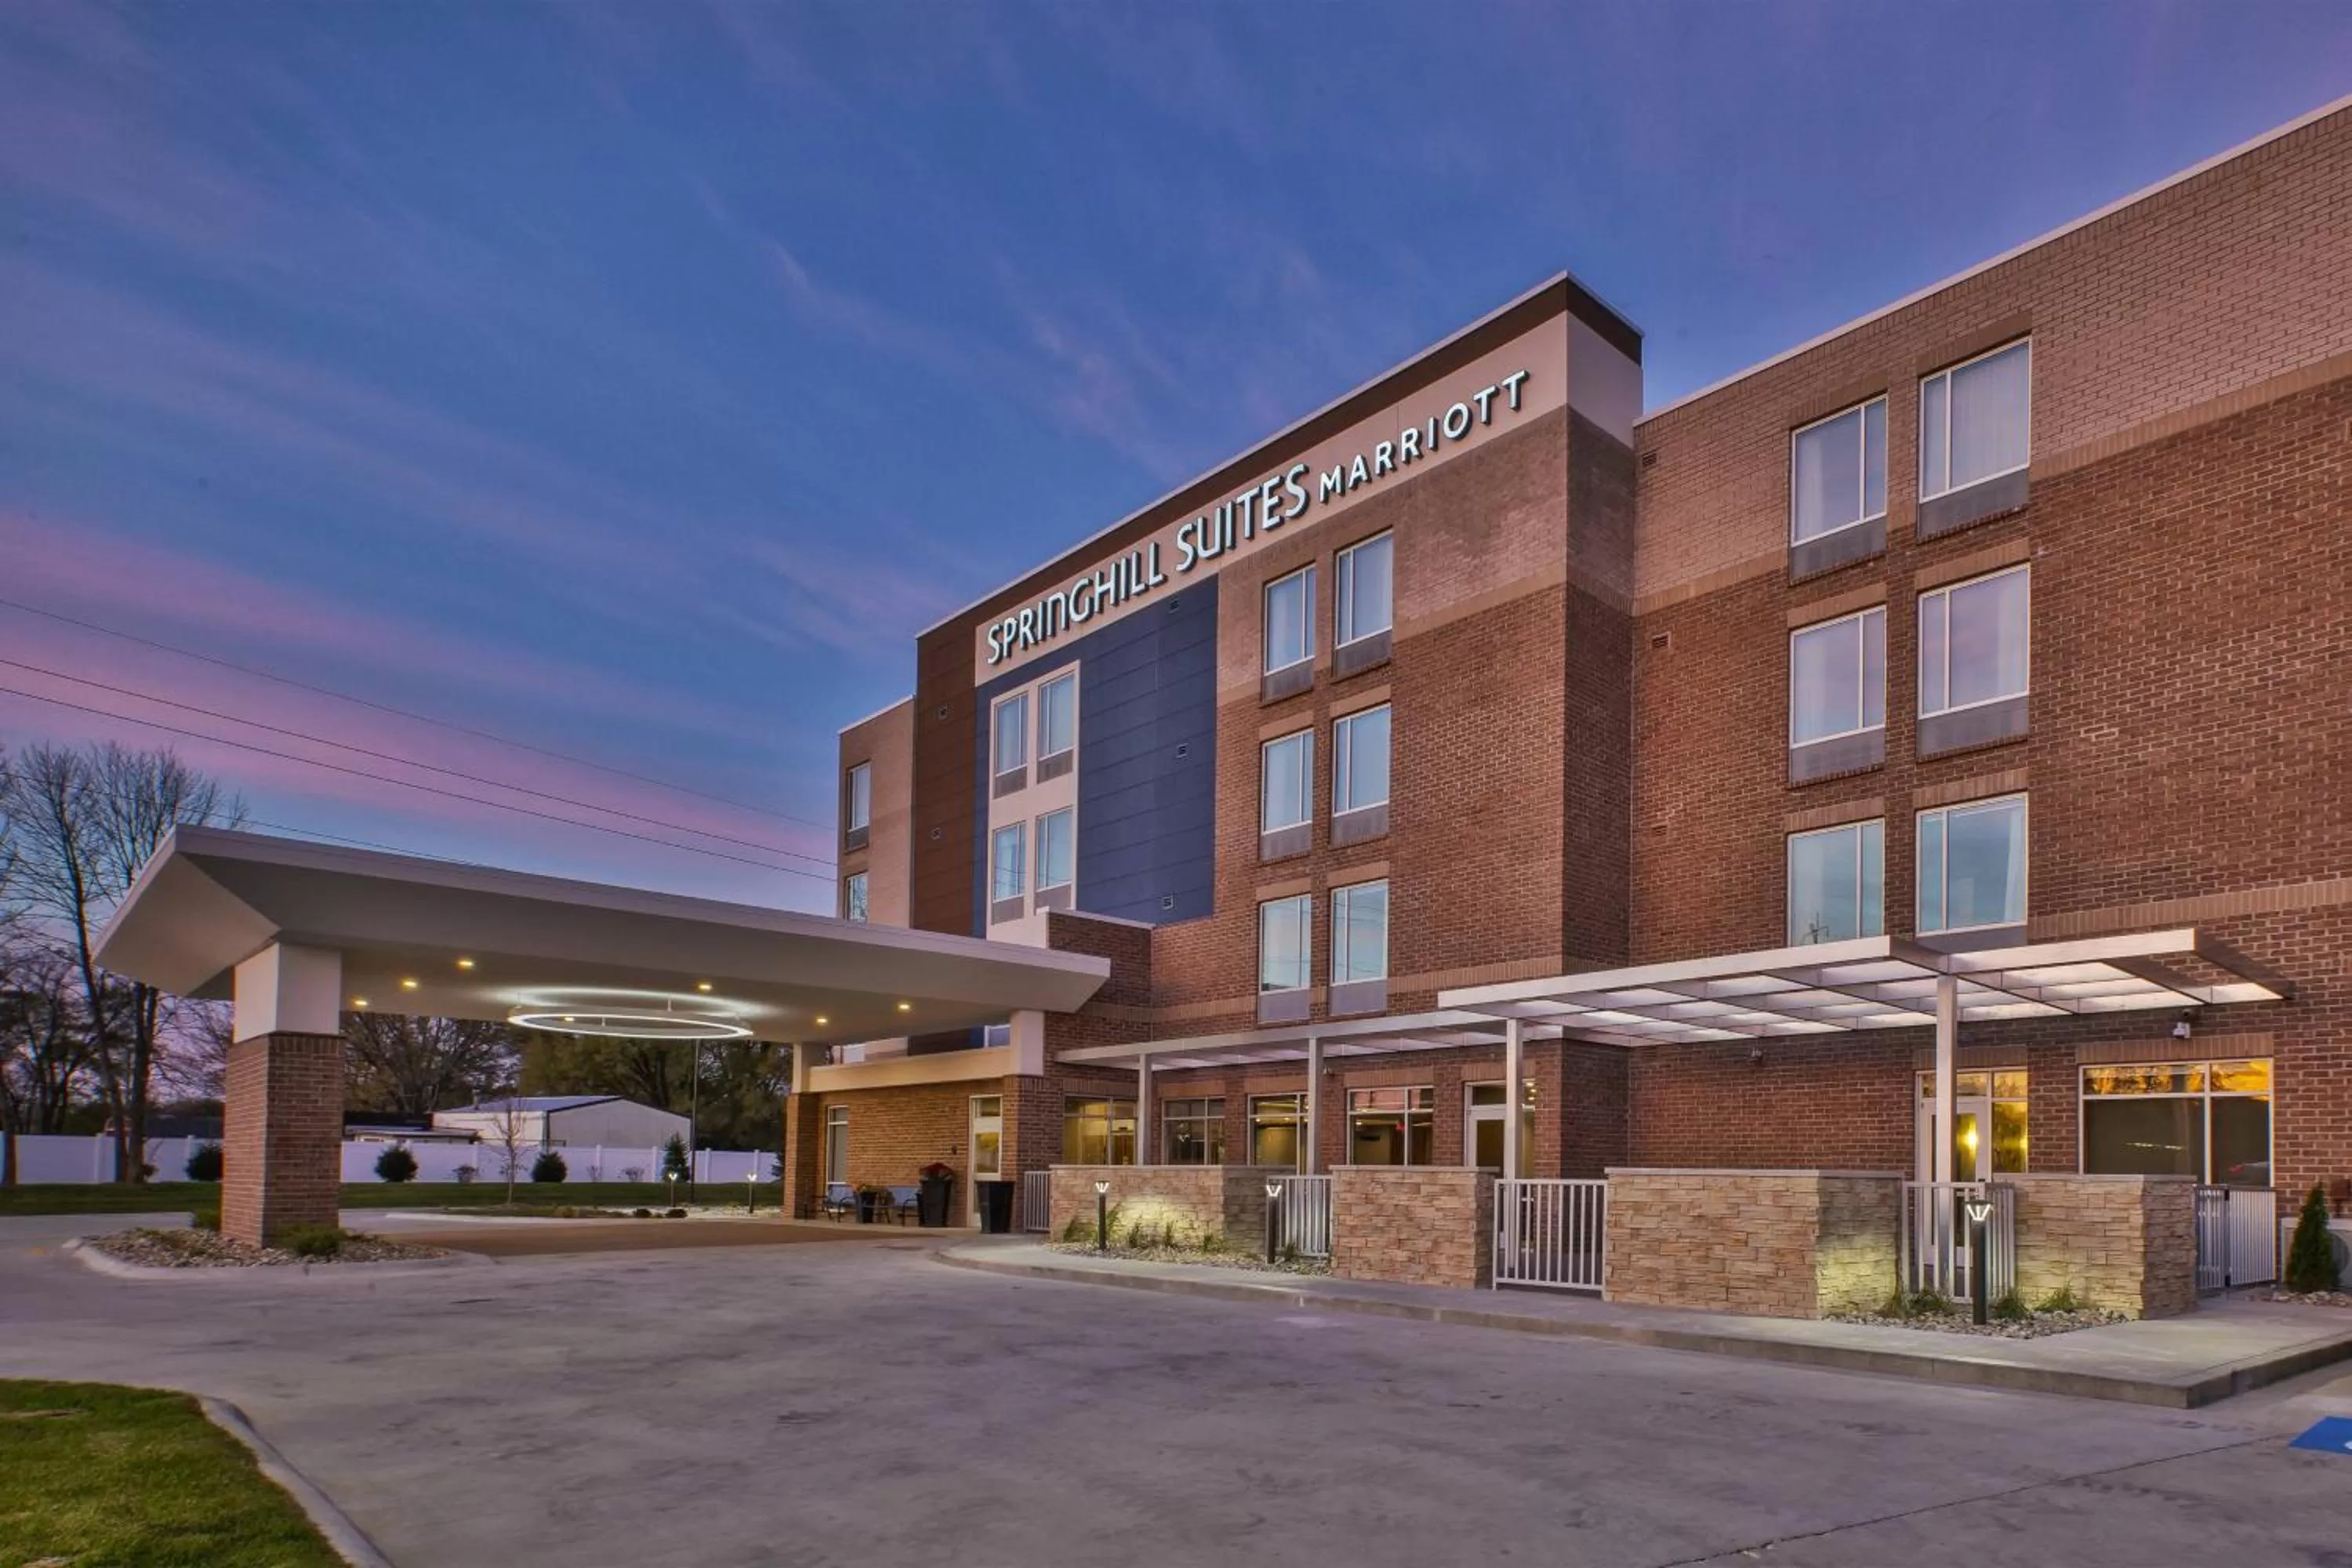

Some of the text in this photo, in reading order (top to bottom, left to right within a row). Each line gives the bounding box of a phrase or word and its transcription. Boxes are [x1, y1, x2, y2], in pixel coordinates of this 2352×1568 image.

[987, 369, 1530, 665] SPRINGHILL SUITES MARRIOTT
